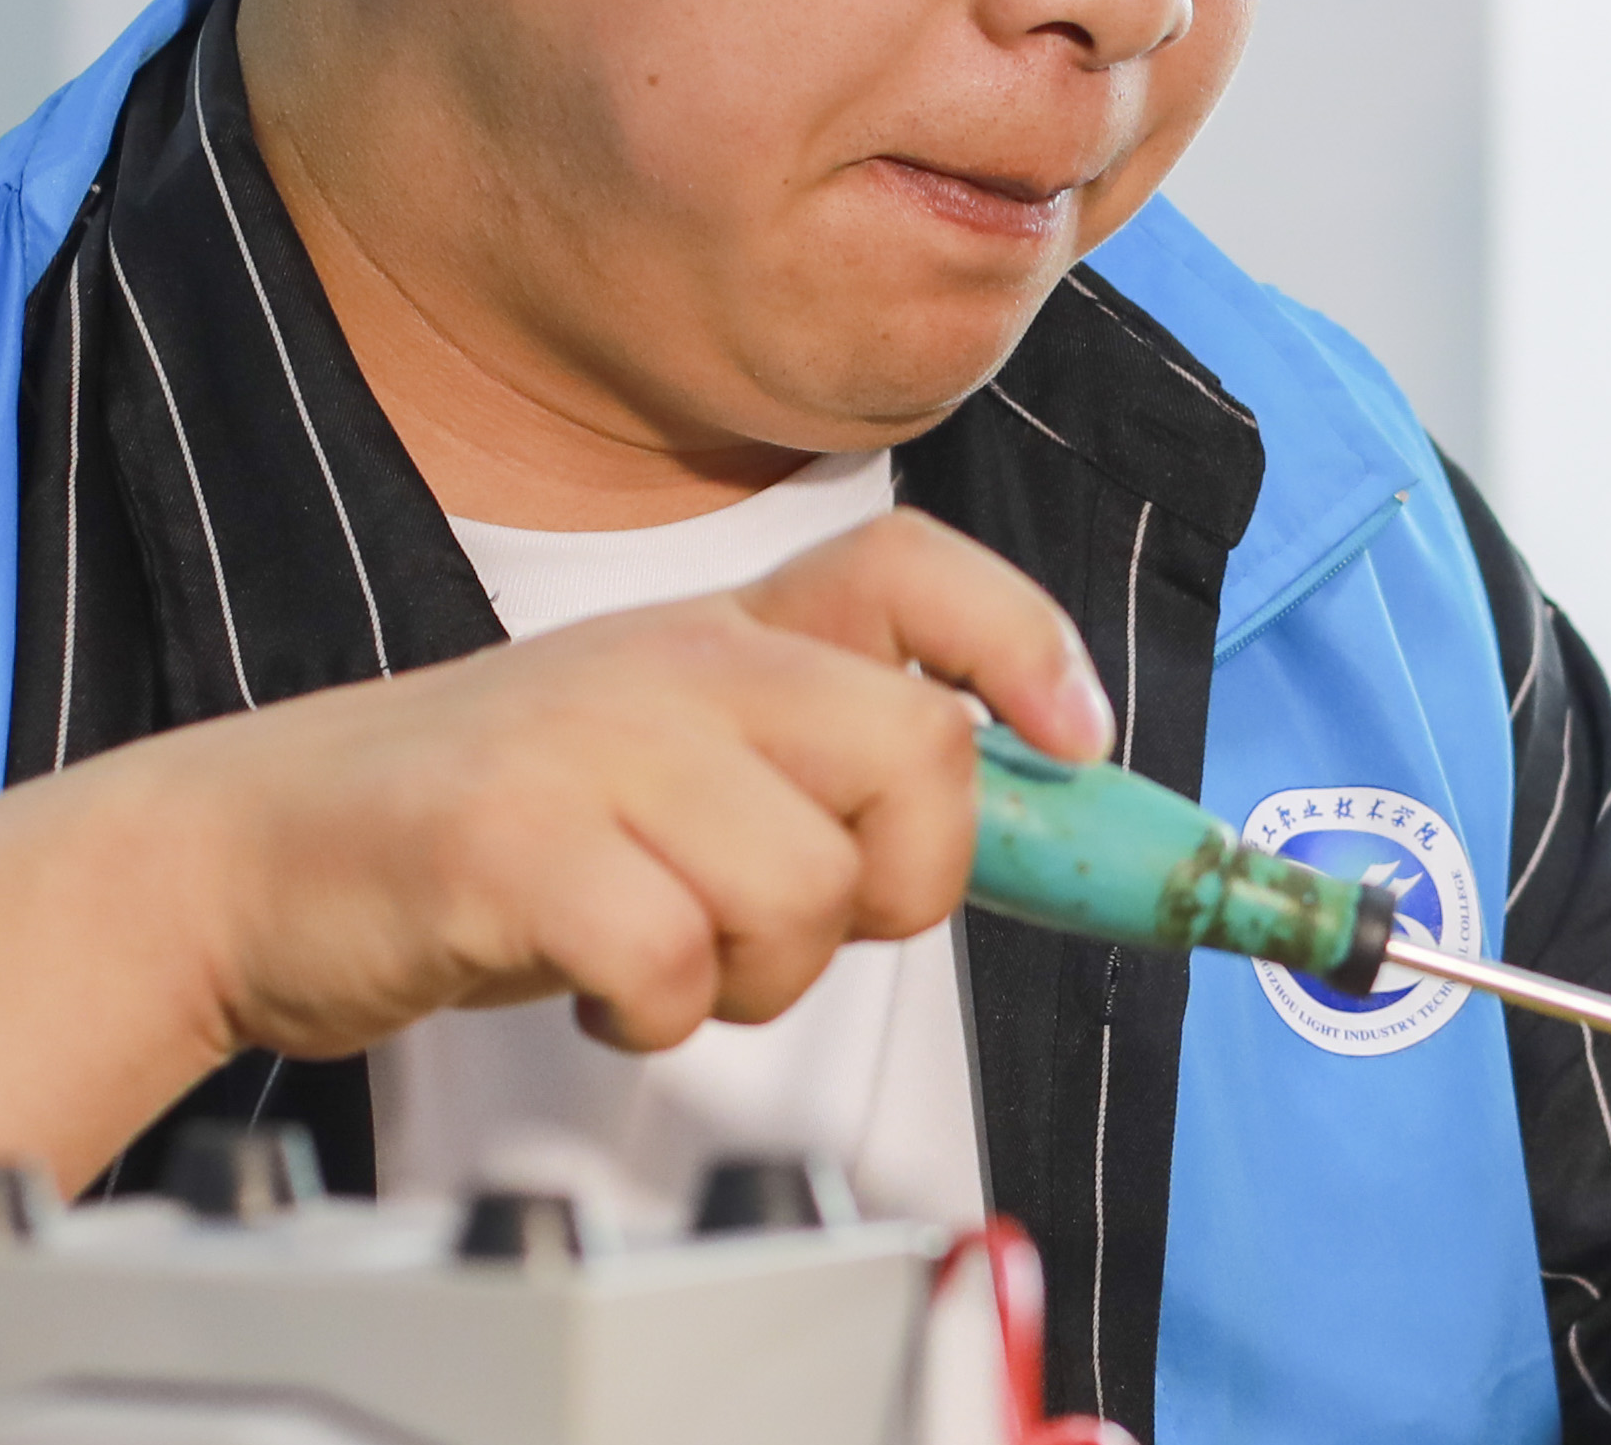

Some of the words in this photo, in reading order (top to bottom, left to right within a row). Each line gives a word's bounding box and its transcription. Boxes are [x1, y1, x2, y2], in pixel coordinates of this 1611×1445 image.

[1258, 957, 1298, 1013] UIZHOU
[1298, 1010, 1340, 1039] LIGHT
[1344, 1014, 1417, 1041] INDUSTRY
[1450, 868, 1470, 942] COLLEGE
